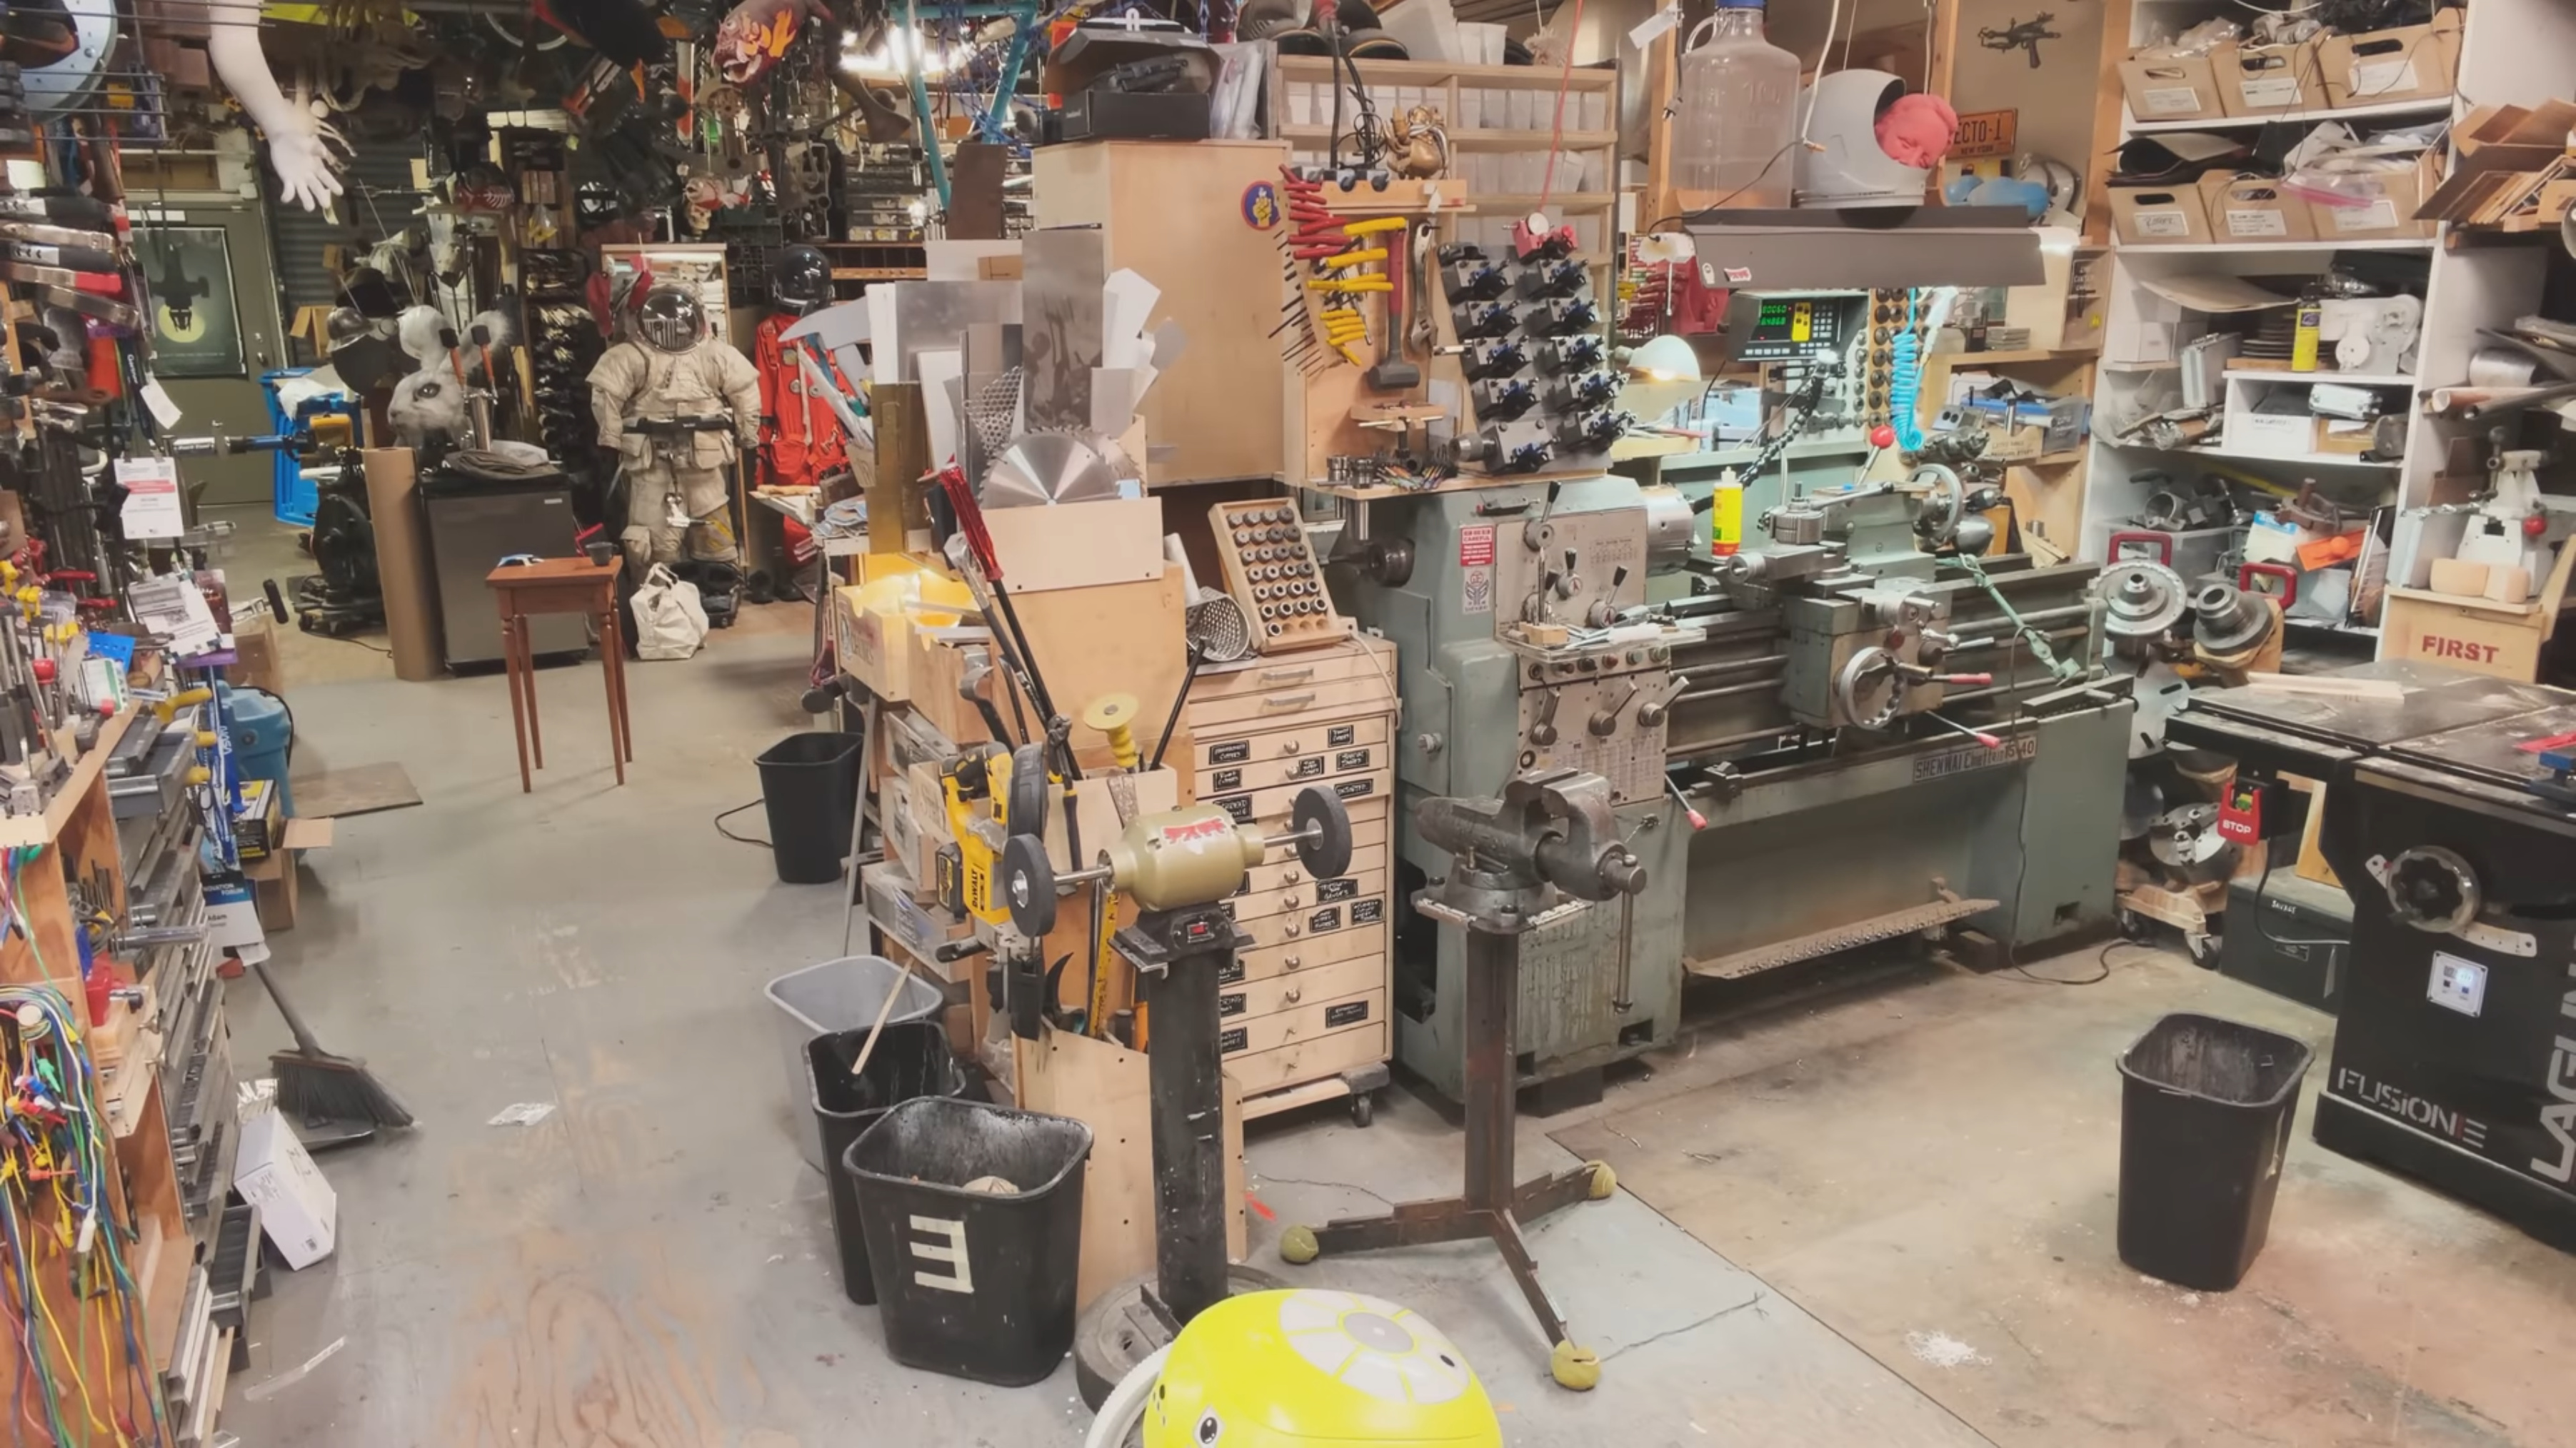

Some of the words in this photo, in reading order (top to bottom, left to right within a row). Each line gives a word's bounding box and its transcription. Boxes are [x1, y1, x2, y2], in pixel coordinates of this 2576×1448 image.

[1953, 119, 2001, 144] ECTO-1
[2422, 635, 2500, 664] FIRST
[2222, 820, 2251, 834] STOP
